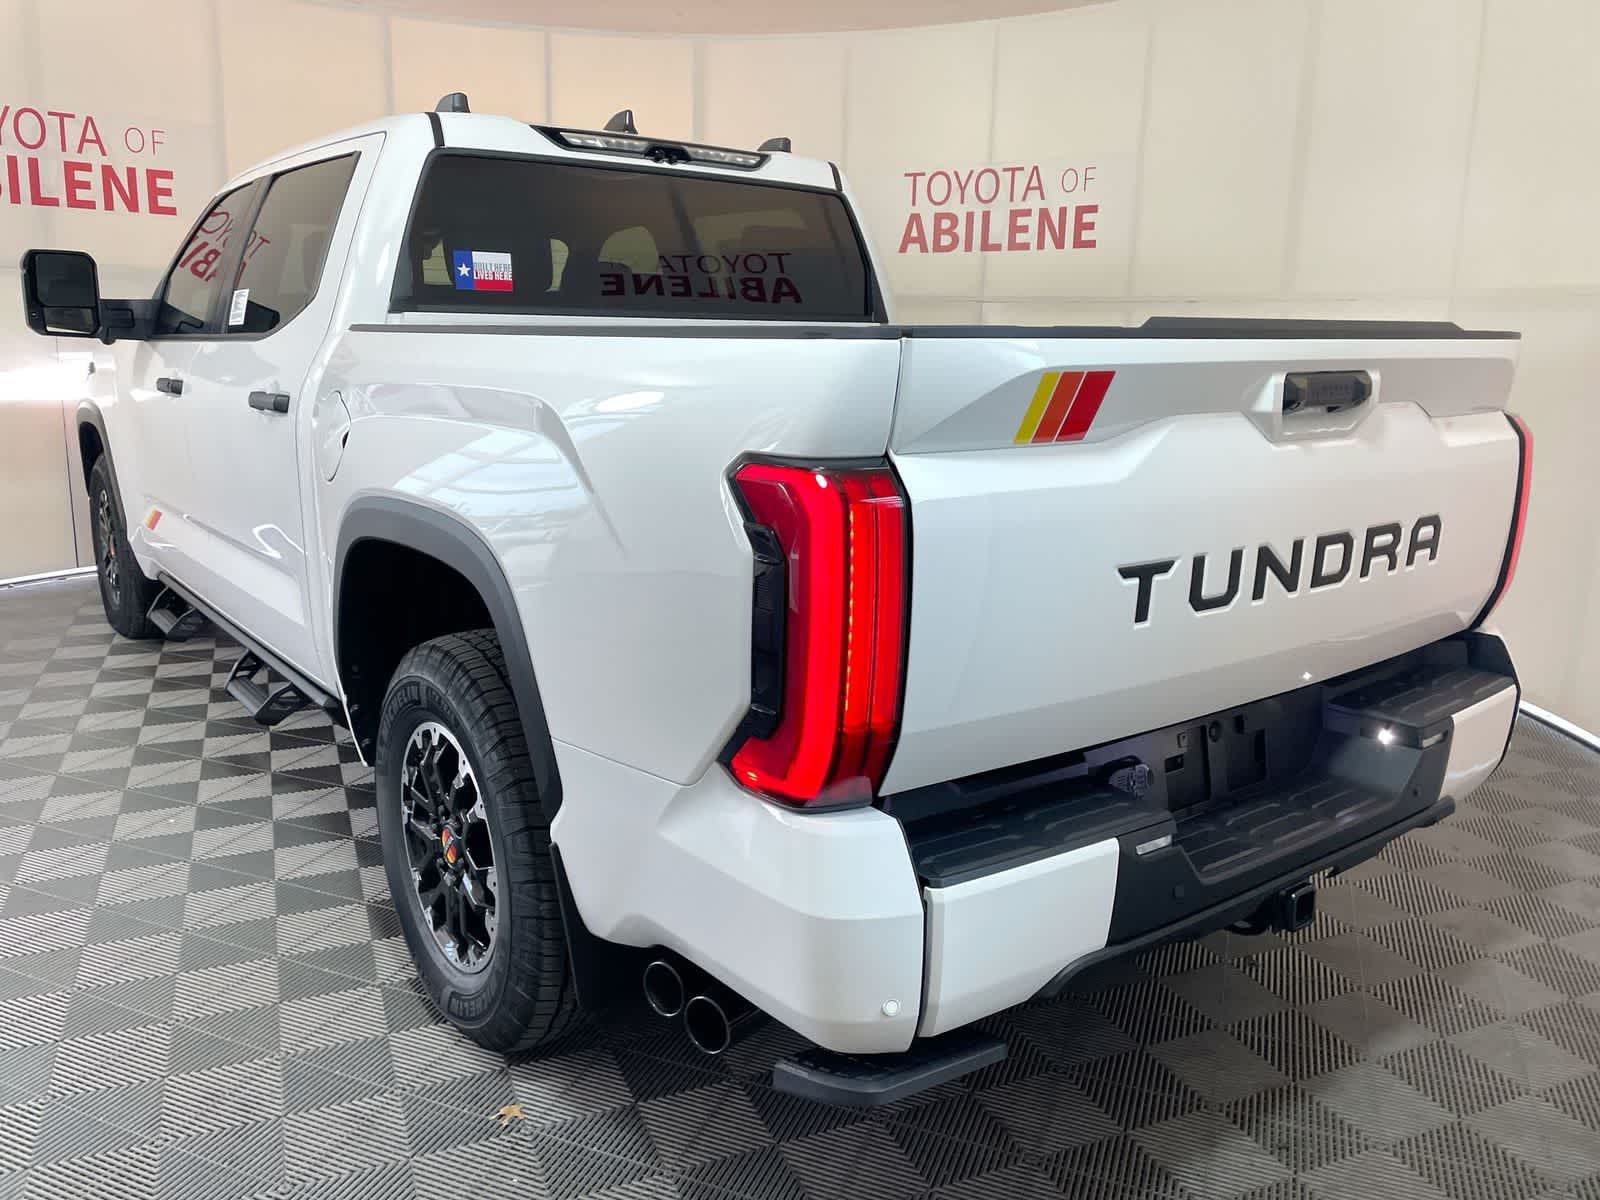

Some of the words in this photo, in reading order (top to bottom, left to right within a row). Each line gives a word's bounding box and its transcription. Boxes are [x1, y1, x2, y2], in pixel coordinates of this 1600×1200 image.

[124, 127, 166, 155] OF
[0, 154, 178, 217] ILENE
[903, 165, 1047, 207] TOYOTA
[1061, 166, 1097, 193] OF
[898, 204, 1099, 253] ABILENE
[473, 270, 494, 281] LIVES
[494, 271, 513, 281] HERE
[1117, 512, 1442, 627] TUNDRA
